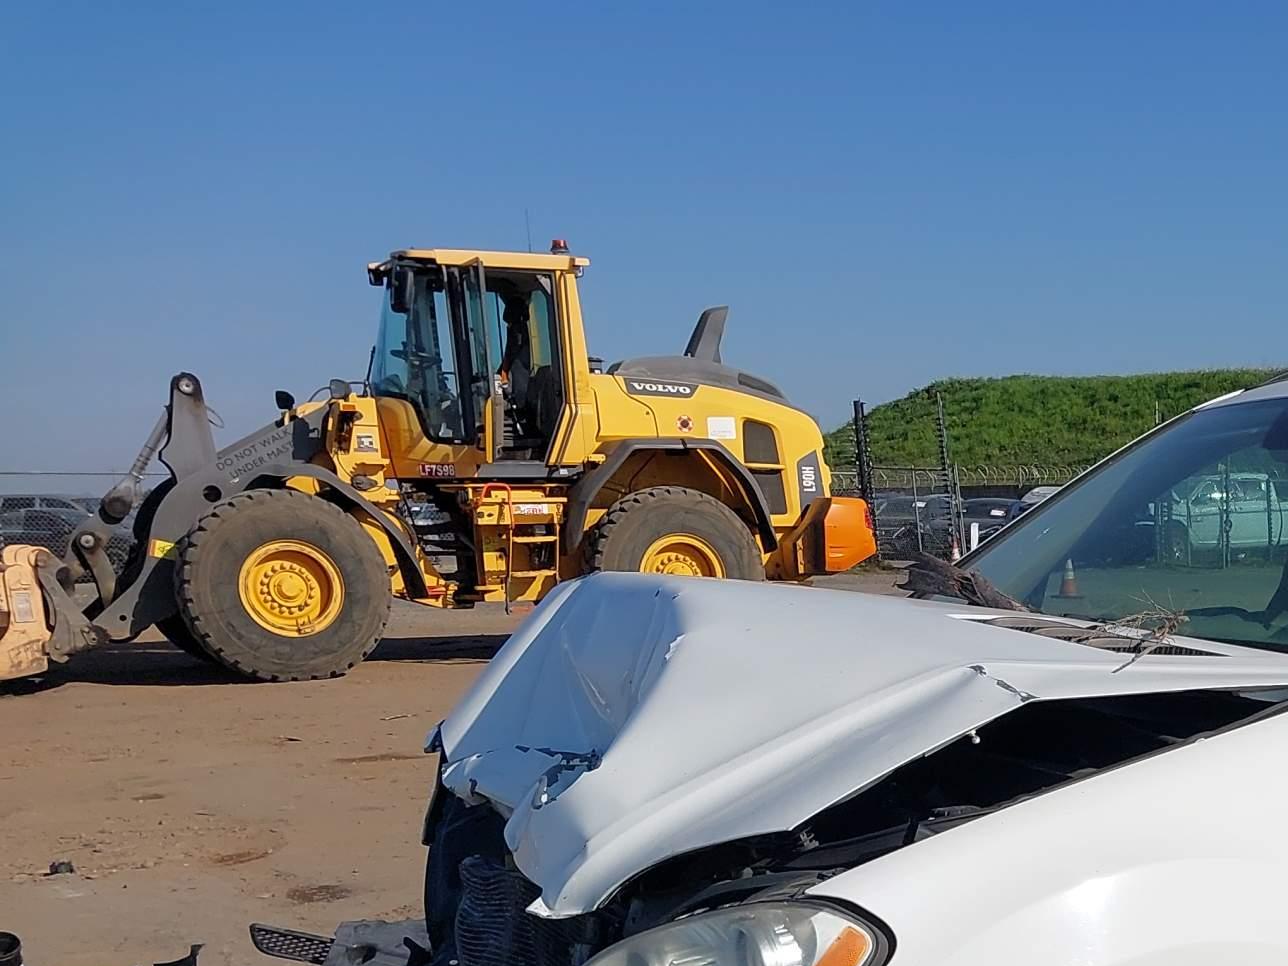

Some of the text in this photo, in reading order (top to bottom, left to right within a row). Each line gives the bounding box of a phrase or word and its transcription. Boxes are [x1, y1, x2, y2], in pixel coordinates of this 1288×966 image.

[629, 381, 691, 395] VOLVO
[215, 427, 292, 472] DO NOT WALK
[229, 456, 268, 479] UNDER
[801, 466, 817, 492] L90H
